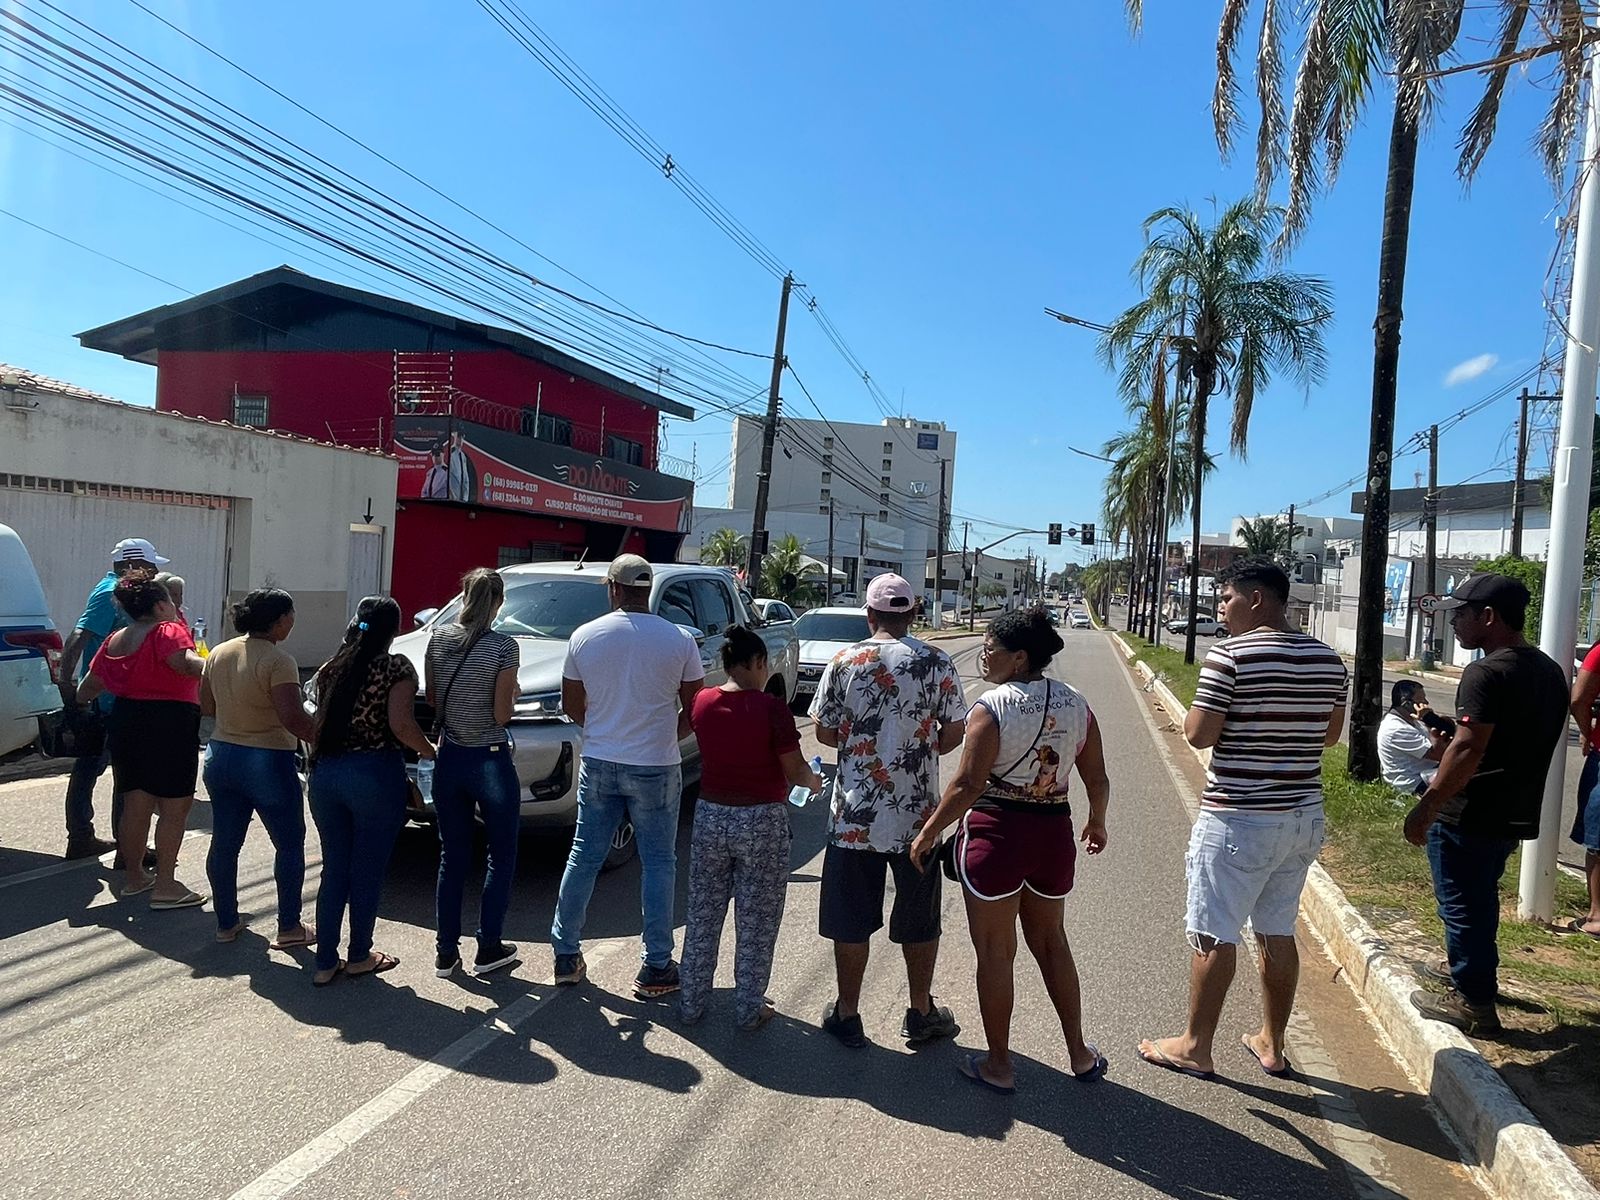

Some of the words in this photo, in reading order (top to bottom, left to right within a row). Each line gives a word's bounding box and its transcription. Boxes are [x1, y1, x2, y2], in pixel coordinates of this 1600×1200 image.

[493, 476, 505, 488] (68)
[568, 464, 588, 485] DO
[589, 466, 630, 496] MONTE
[492, 491, 505, 502] (68)
[578, 493, 586, 502] DO
[587, 494, 604, 505] MONTE
[544, 498, 564, 509] CURSO
[565, 501, 573, 510] DE
[573, 503, 601, 516] FORMAÇÃO
[601, 508, 608, 516] DE
